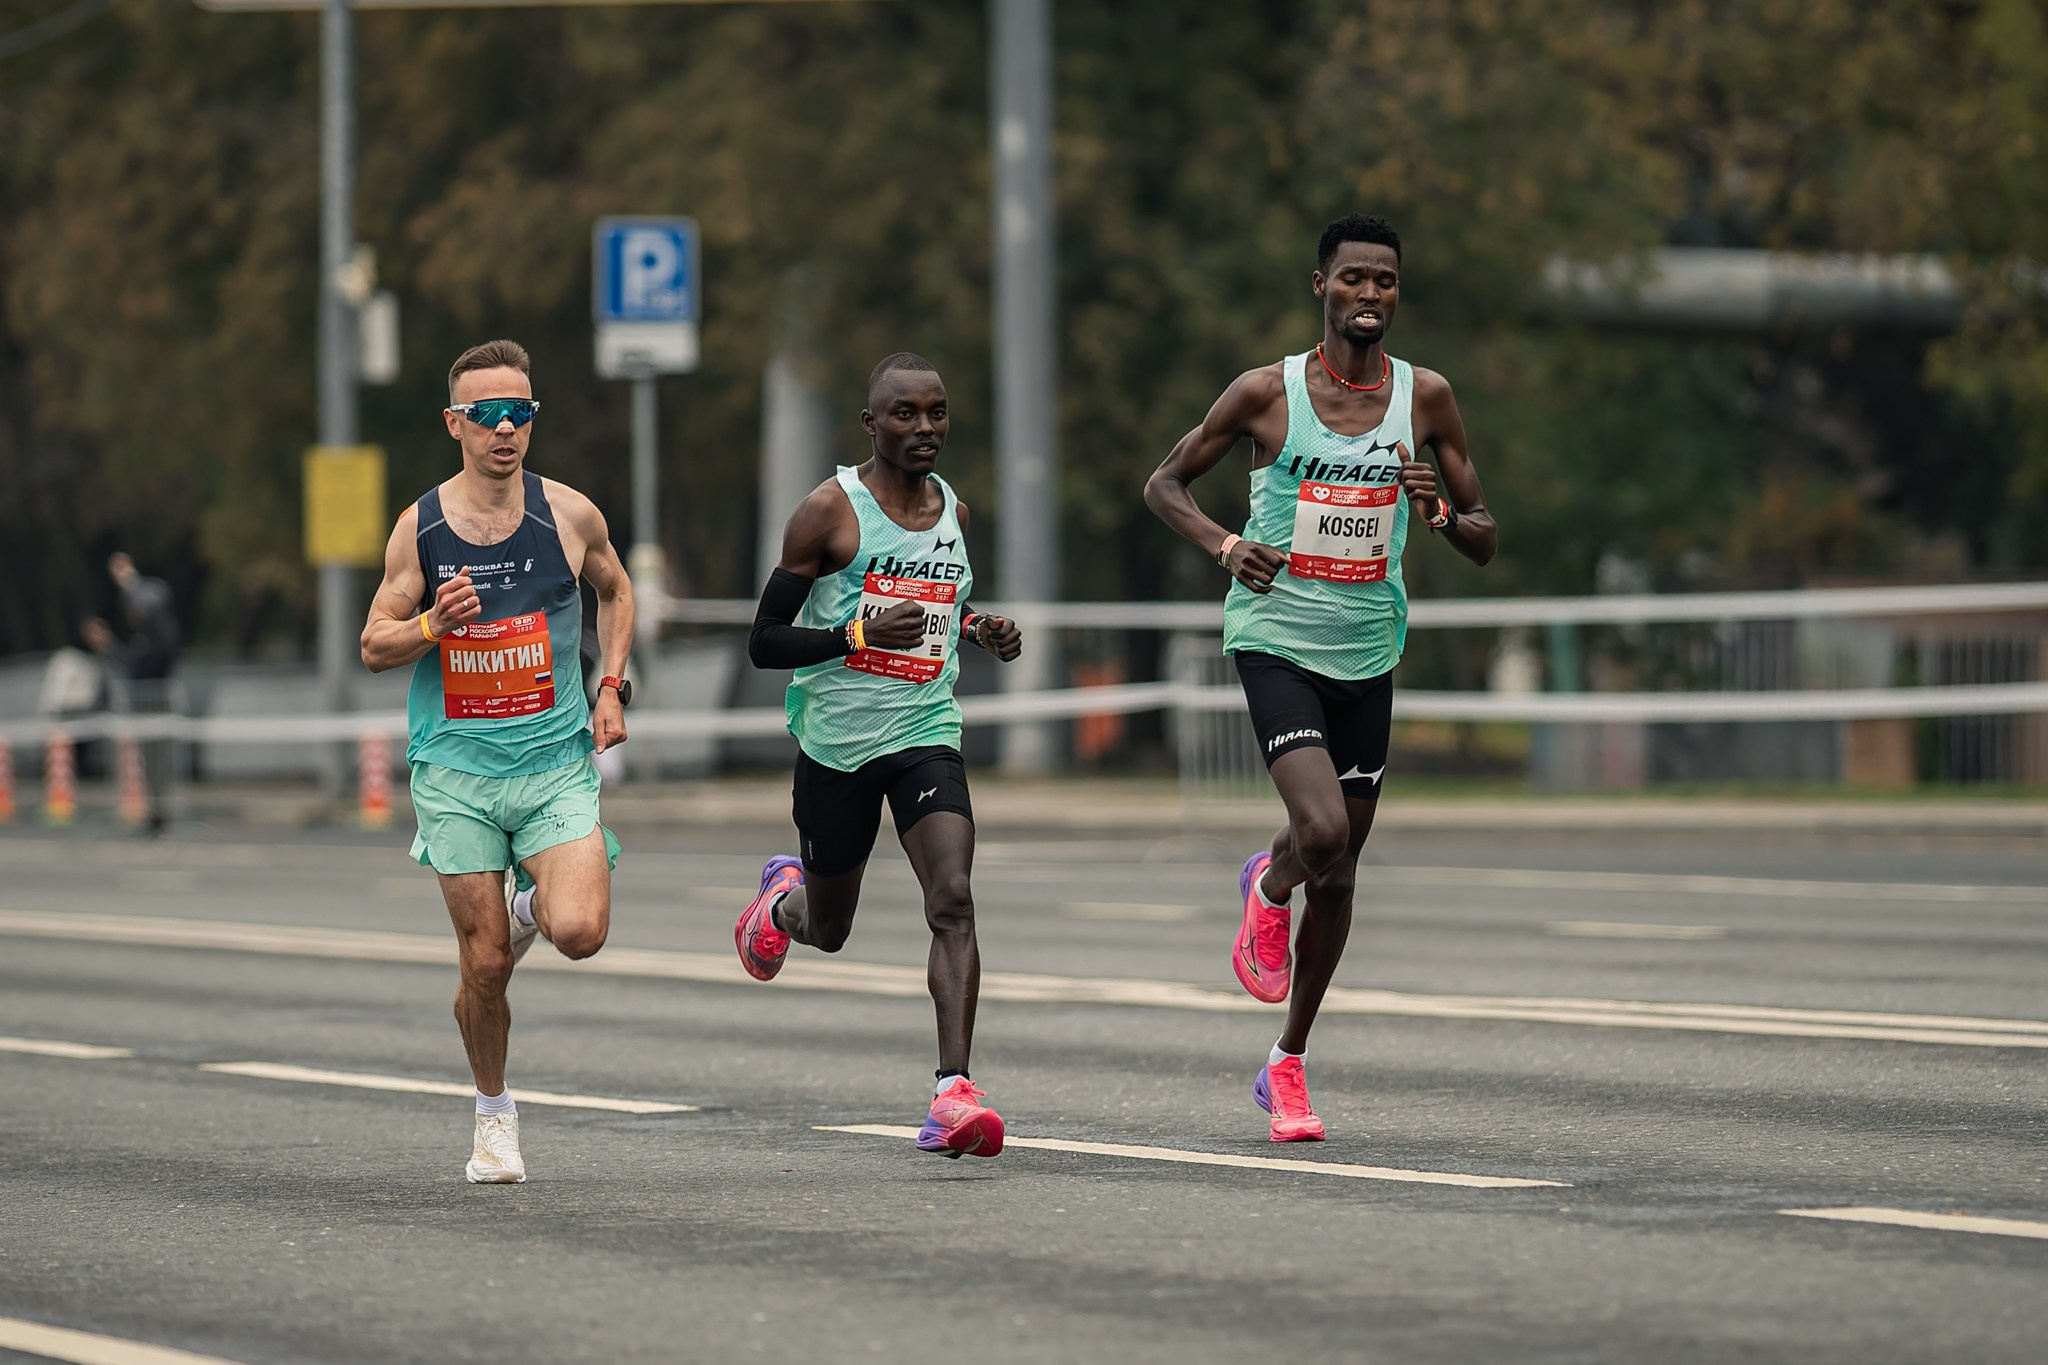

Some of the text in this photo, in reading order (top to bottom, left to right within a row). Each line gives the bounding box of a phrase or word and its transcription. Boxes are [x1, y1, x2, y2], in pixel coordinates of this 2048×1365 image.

[1318, 514, 1380, 538] KOSGEI
[1344, 548, 1350, 556] 2
[863, 556, 966, 581] HIRACER
[472, 582, 491, 590] mazfit
[469, 625, 508, 633] МОСКОВСКИЙ
[449, 642, 546, 673] НИКИТИН
[496, 681, 502, 690] 1
[1268, 729, 1322, 752] HIRACER
